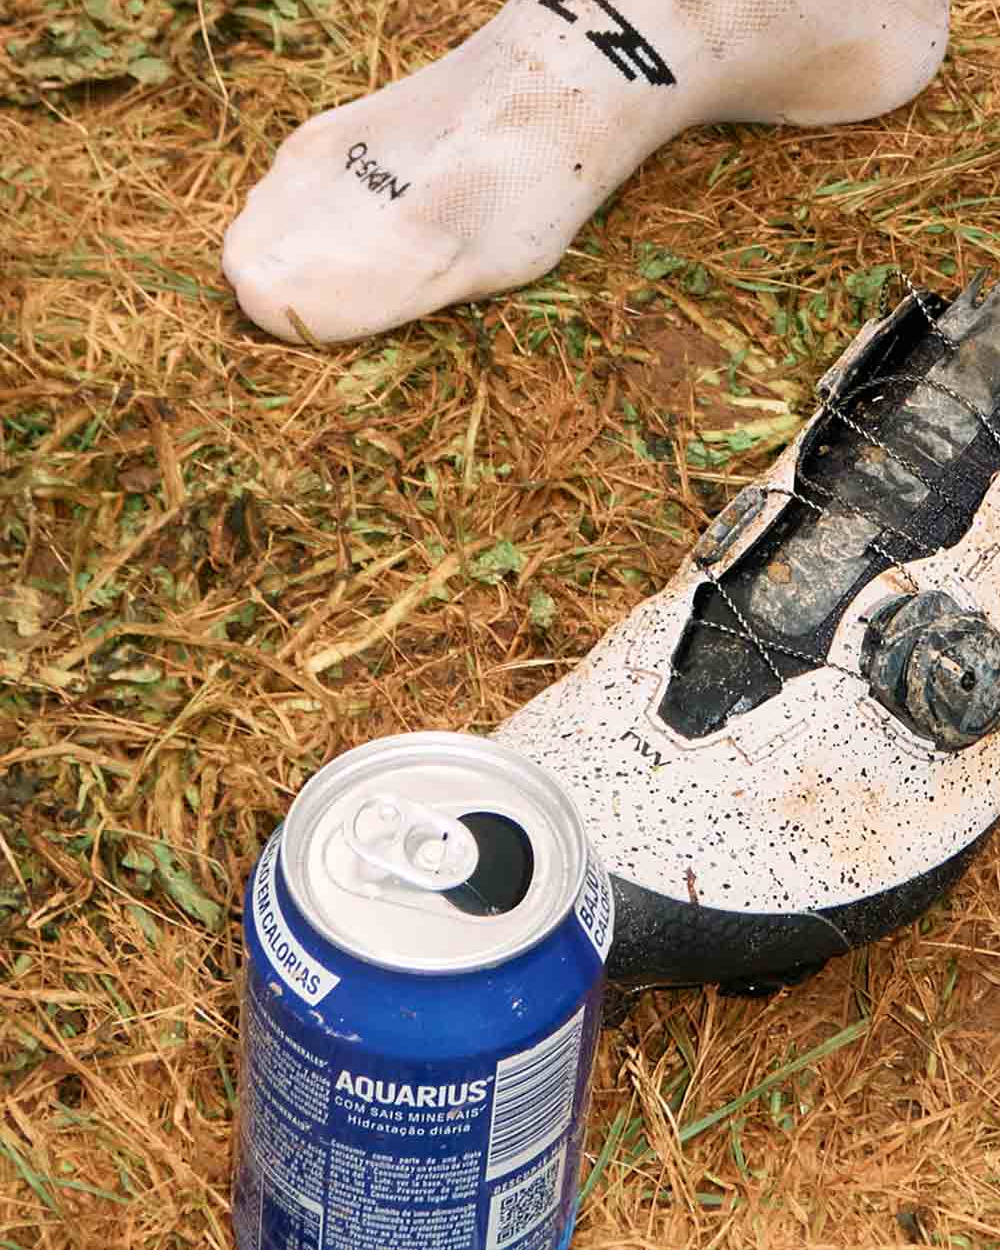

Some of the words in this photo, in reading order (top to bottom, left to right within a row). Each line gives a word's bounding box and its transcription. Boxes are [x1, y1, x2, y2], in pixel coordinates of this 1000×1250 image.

[261, 912, 321, 995] CALORIAS
[335, 1070, 488, 1108] AQUARIUS
[335, 1096, 365, 1113] COM
[370, 1107, 403, 1121] SAIS
[347, 1114, 425, 1137] Hidratação
[430, 1123, 471, 1136] diária
